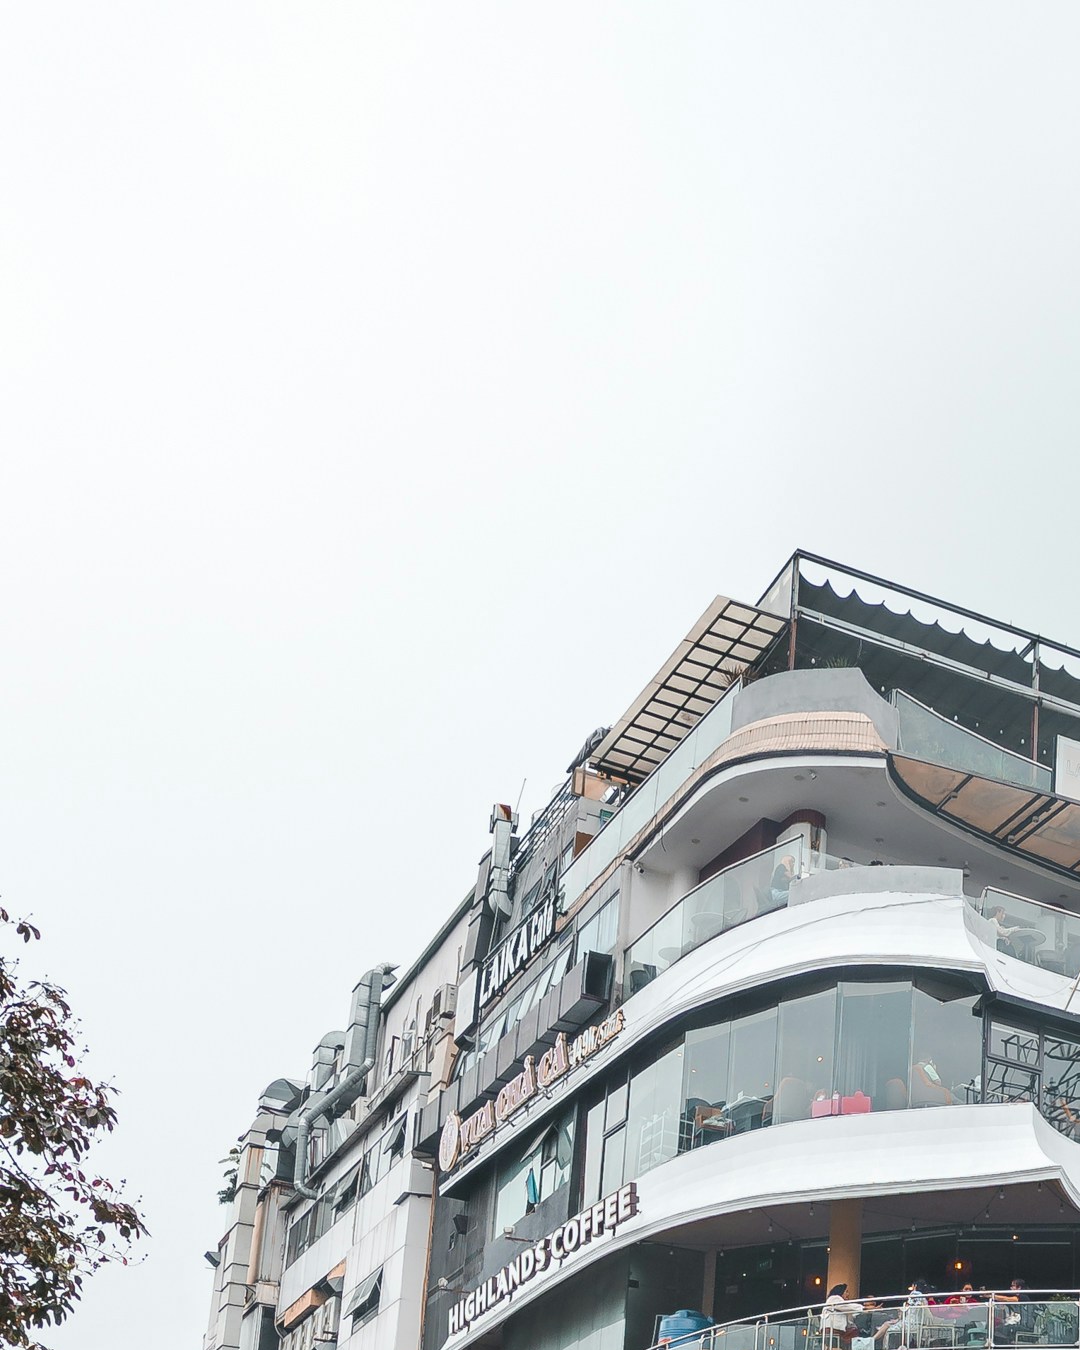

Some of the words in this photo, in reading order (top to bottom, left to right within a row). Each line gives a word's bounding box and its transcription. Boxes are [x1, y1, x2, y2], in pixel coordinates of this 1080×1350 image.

[479, 923, 528, 1007] LAIKA
[460, 1100, 496, 1153] VUA
[495, 1055, 537, 1121] CHẢ
[537, 1032, 570, 1087] CÁ
[448, 1238, 550, 1336] HIGHLANDS
[551, 1182, 639, 1262] COFFEE
